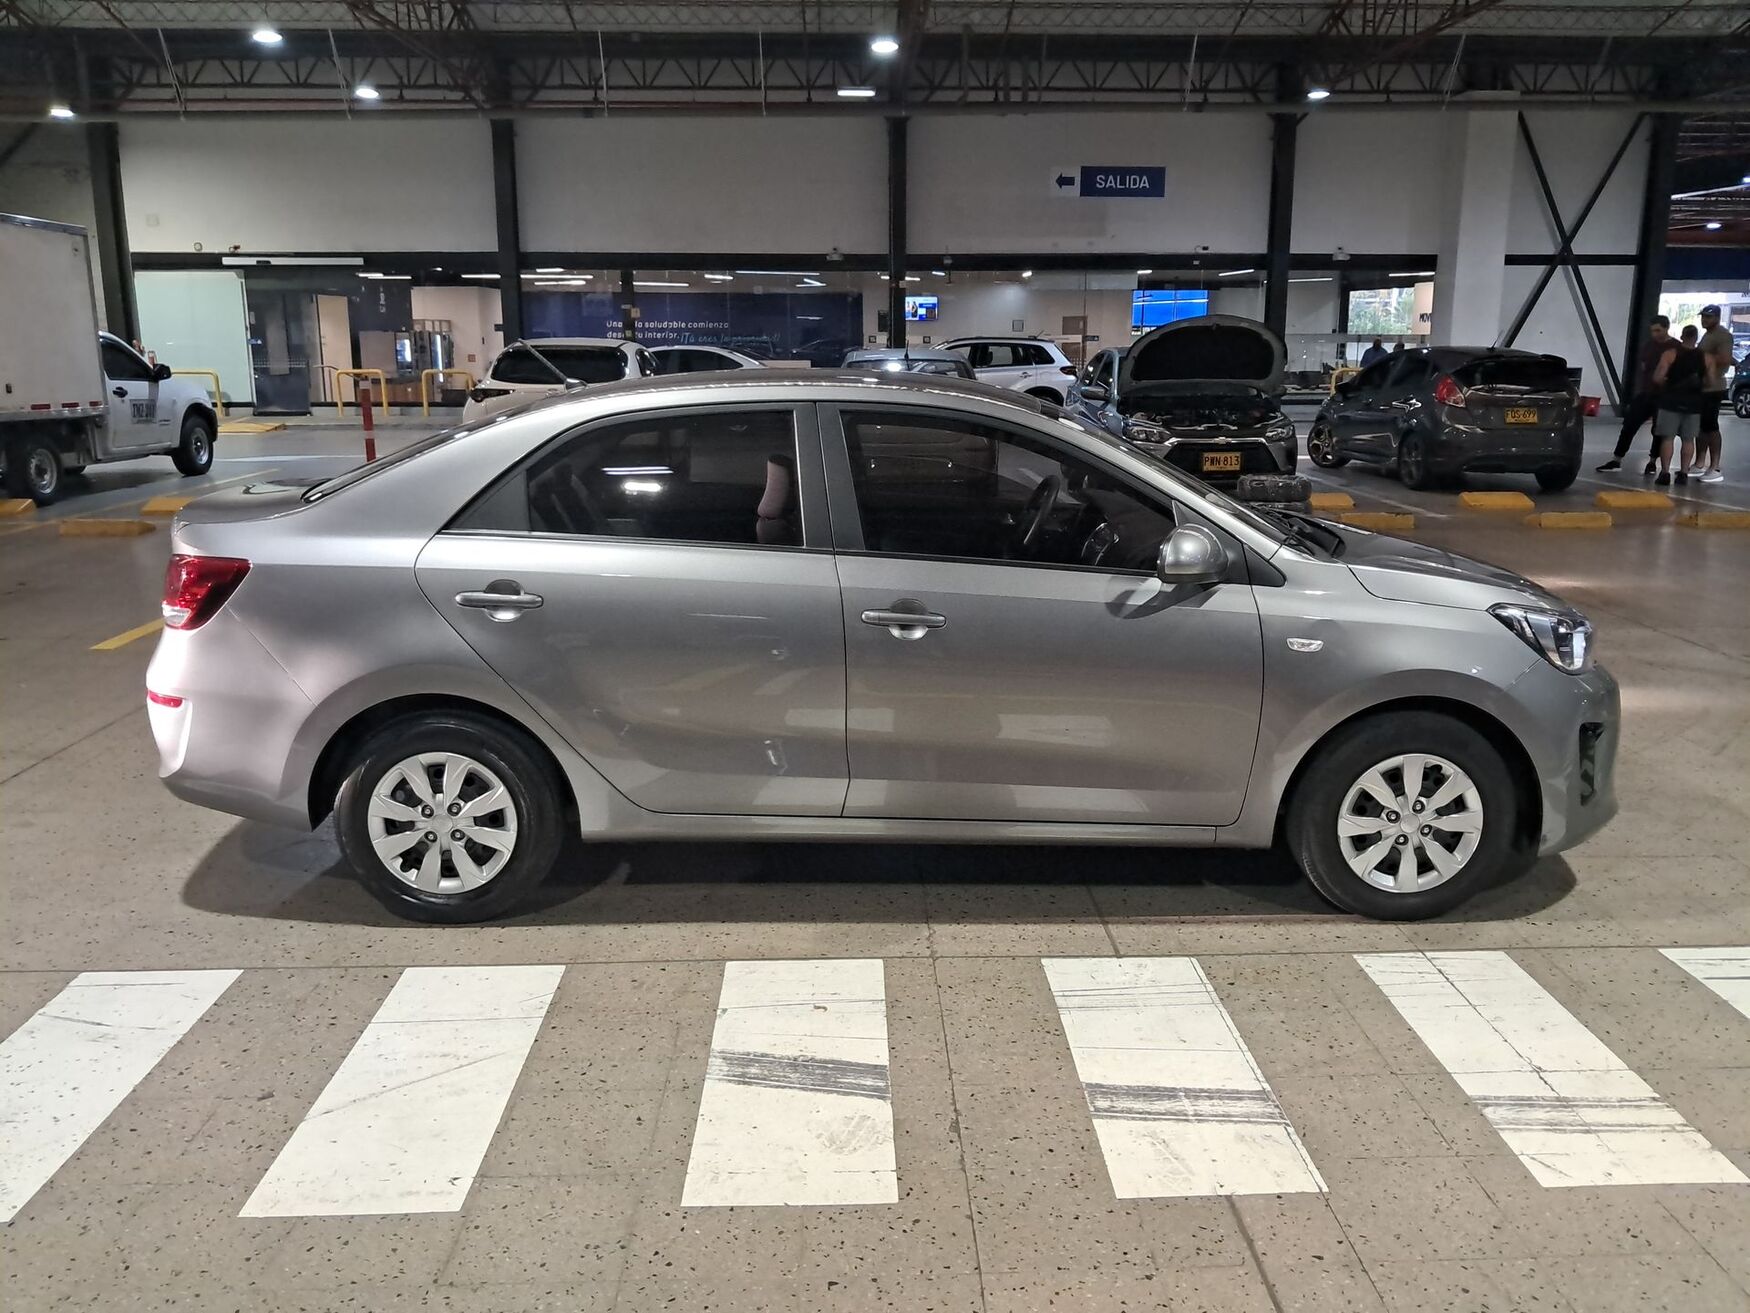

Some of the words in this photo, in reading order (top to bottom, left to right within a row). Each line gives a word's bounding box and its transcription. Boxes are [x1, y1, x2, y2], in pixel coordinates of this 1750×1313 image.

[1095, 174, 1150, 189] SALIDA
[606, 320, 623, 328] Una
[644, 320, 686, 328] saludable
[687, 320, 729, 329] comienza
